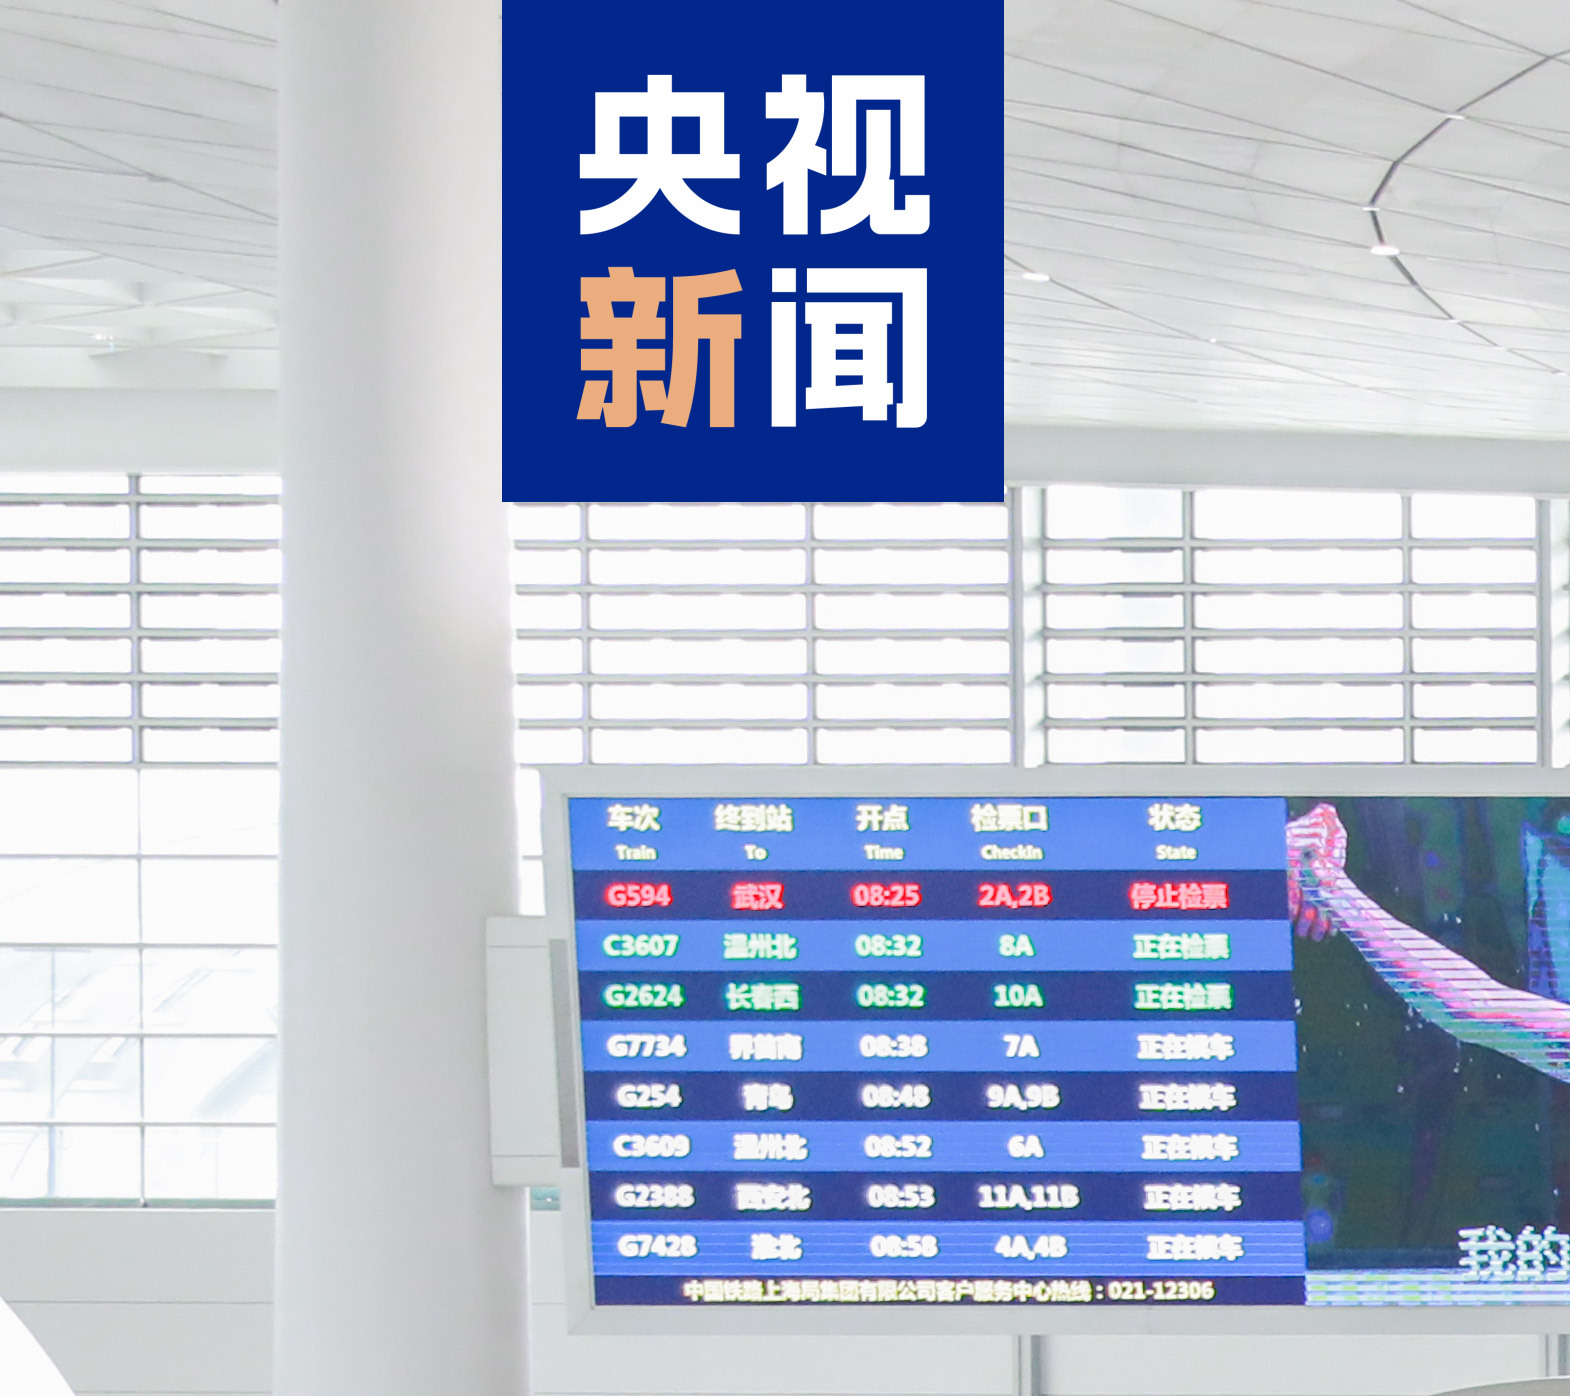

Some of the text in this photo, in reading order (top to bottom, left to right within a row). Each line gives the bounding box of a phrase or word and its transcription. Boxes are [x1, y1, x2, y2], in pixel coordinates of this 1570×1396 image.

[607, 803, 1201, 832] 车次 终到站 开点 检票口 状态
[615, 844, 656, 859] Train
[744, 844, 766, 859] To
[863, 844, 903, 859] Time
[1156, 844, 1196, 859] State
[604, 881, 1229, 910] G594 武汉 08:25 2A,2B 停止检票
[604, 933, 1228, 959] C3607 温州北 08:32 8A 正在检票
[606, 984, 1231, 1009] G2624 长春西 08:32 10A 正在检票
[606, 1034, 687, 1056] G7734
[859, 1034, 928, 1057] 08:38
[1003, 1034, 1039, 1057] 7A
[1137, 1033, 1234, 1060] 正在候车
[616, 1083, 1236, 1110] G254 青岛 08:48 9A,9B 正在候车
[613, 1133, 1238, 1160] C3609 温州北 08:52 6A 正在候车
[614, 1183, 1241, 1211] G2388 西安北 08:53 11A,11B 正在候车
[617, 1233, 1244, 1260] G7428 淮北 08:58 4A,4B 正在候车
